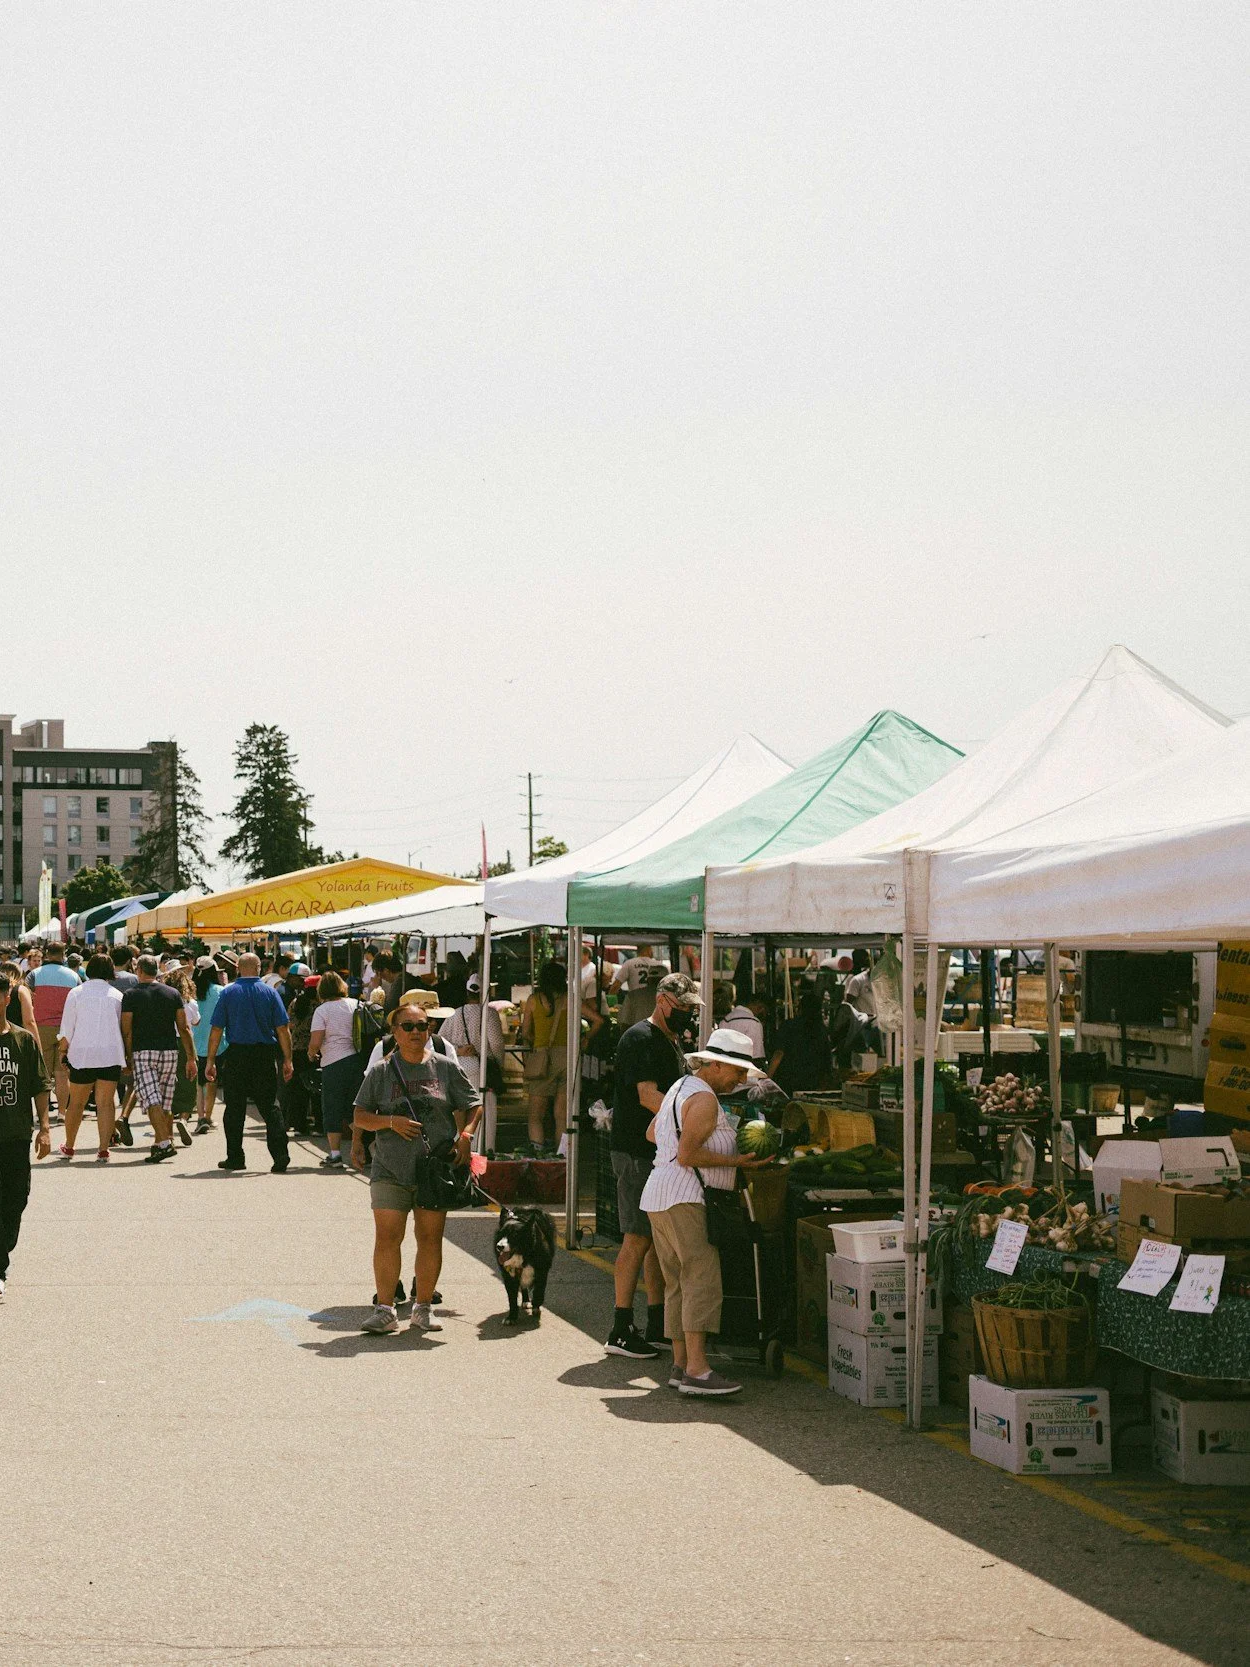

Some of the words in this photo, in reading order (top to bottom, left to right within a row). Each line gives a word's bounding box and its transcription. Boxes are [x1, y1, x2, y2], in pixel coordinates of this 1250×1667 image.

[317, 880, 370, 892] Yolanda
[376, 880, 414, 892] Fruits
[243, 900, 336, 917] NIAGARA
[837, 1344, 853, 1362] Fresh
[1029, 1411, 1053, 1419] RIVER
